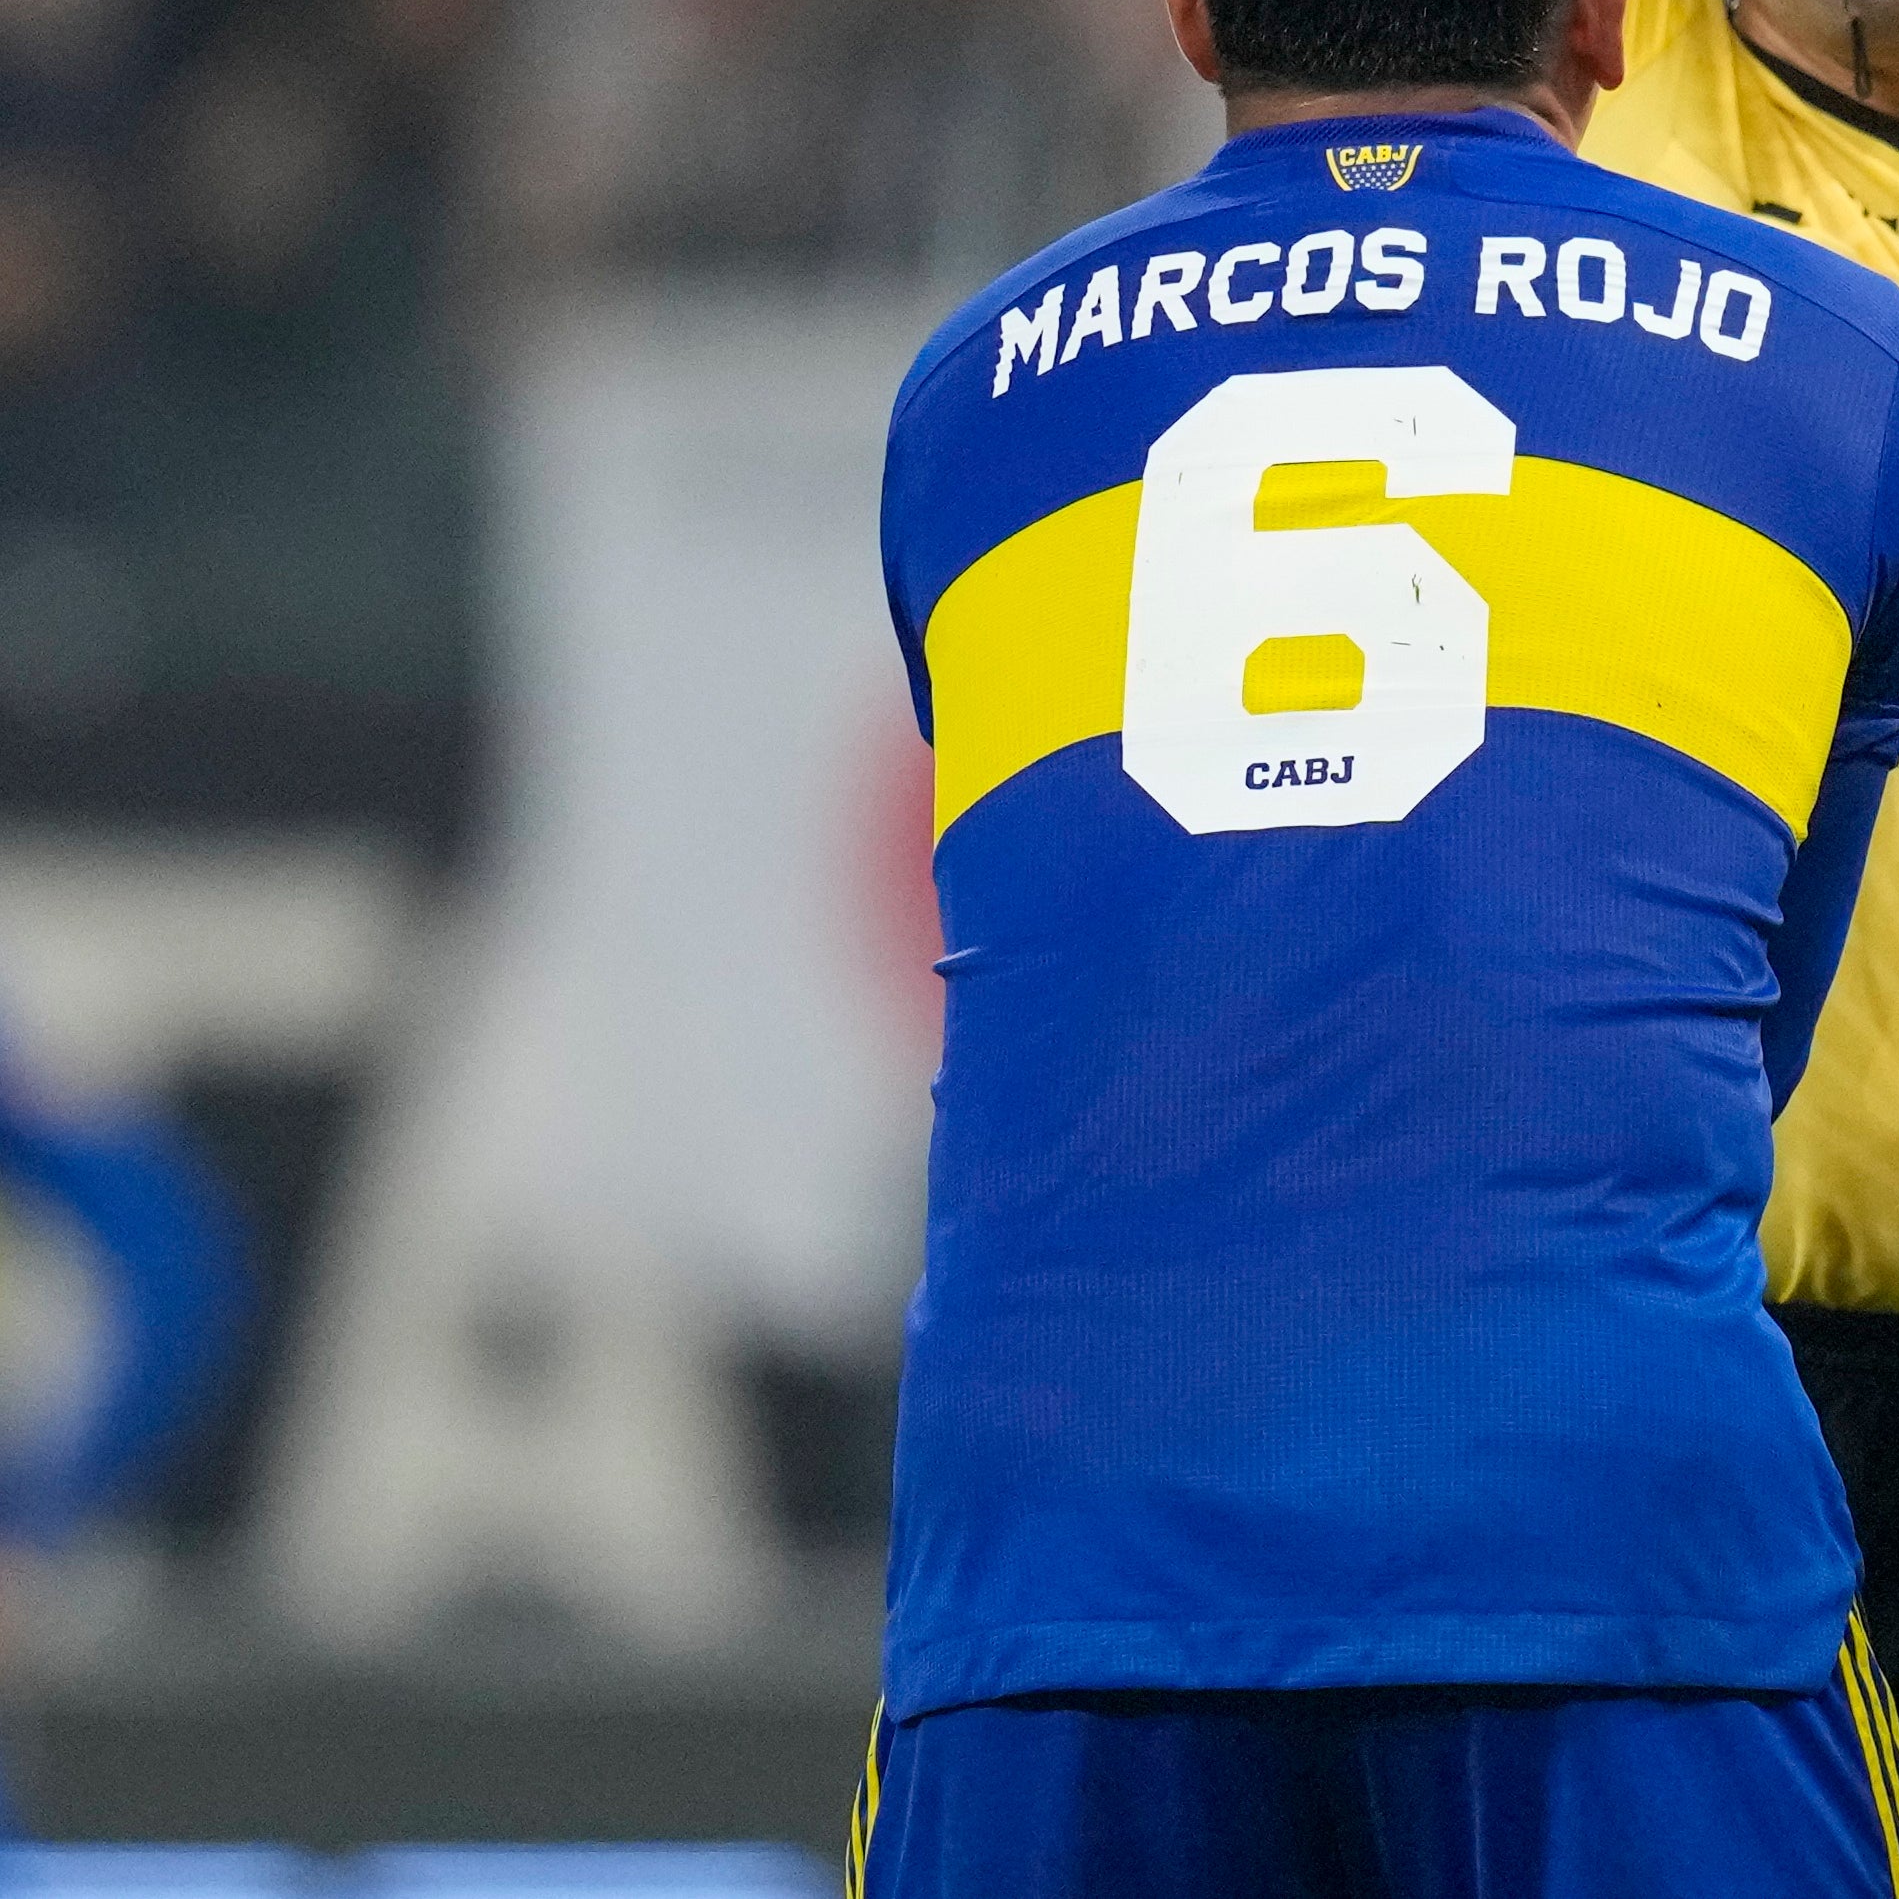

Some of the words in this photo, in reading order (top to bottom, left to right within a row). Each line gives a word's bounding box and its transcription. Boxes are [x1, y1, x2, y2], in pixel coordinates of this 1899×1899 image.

[1340, 145, 1409, 167] CABJ
[992, 228, 1427, 399] MARCOS
[1474, 236, 1772, 362] ROJO
[1121, 365, 1517, 836] 6
[1245, 755, 1355, 790] CABJ
